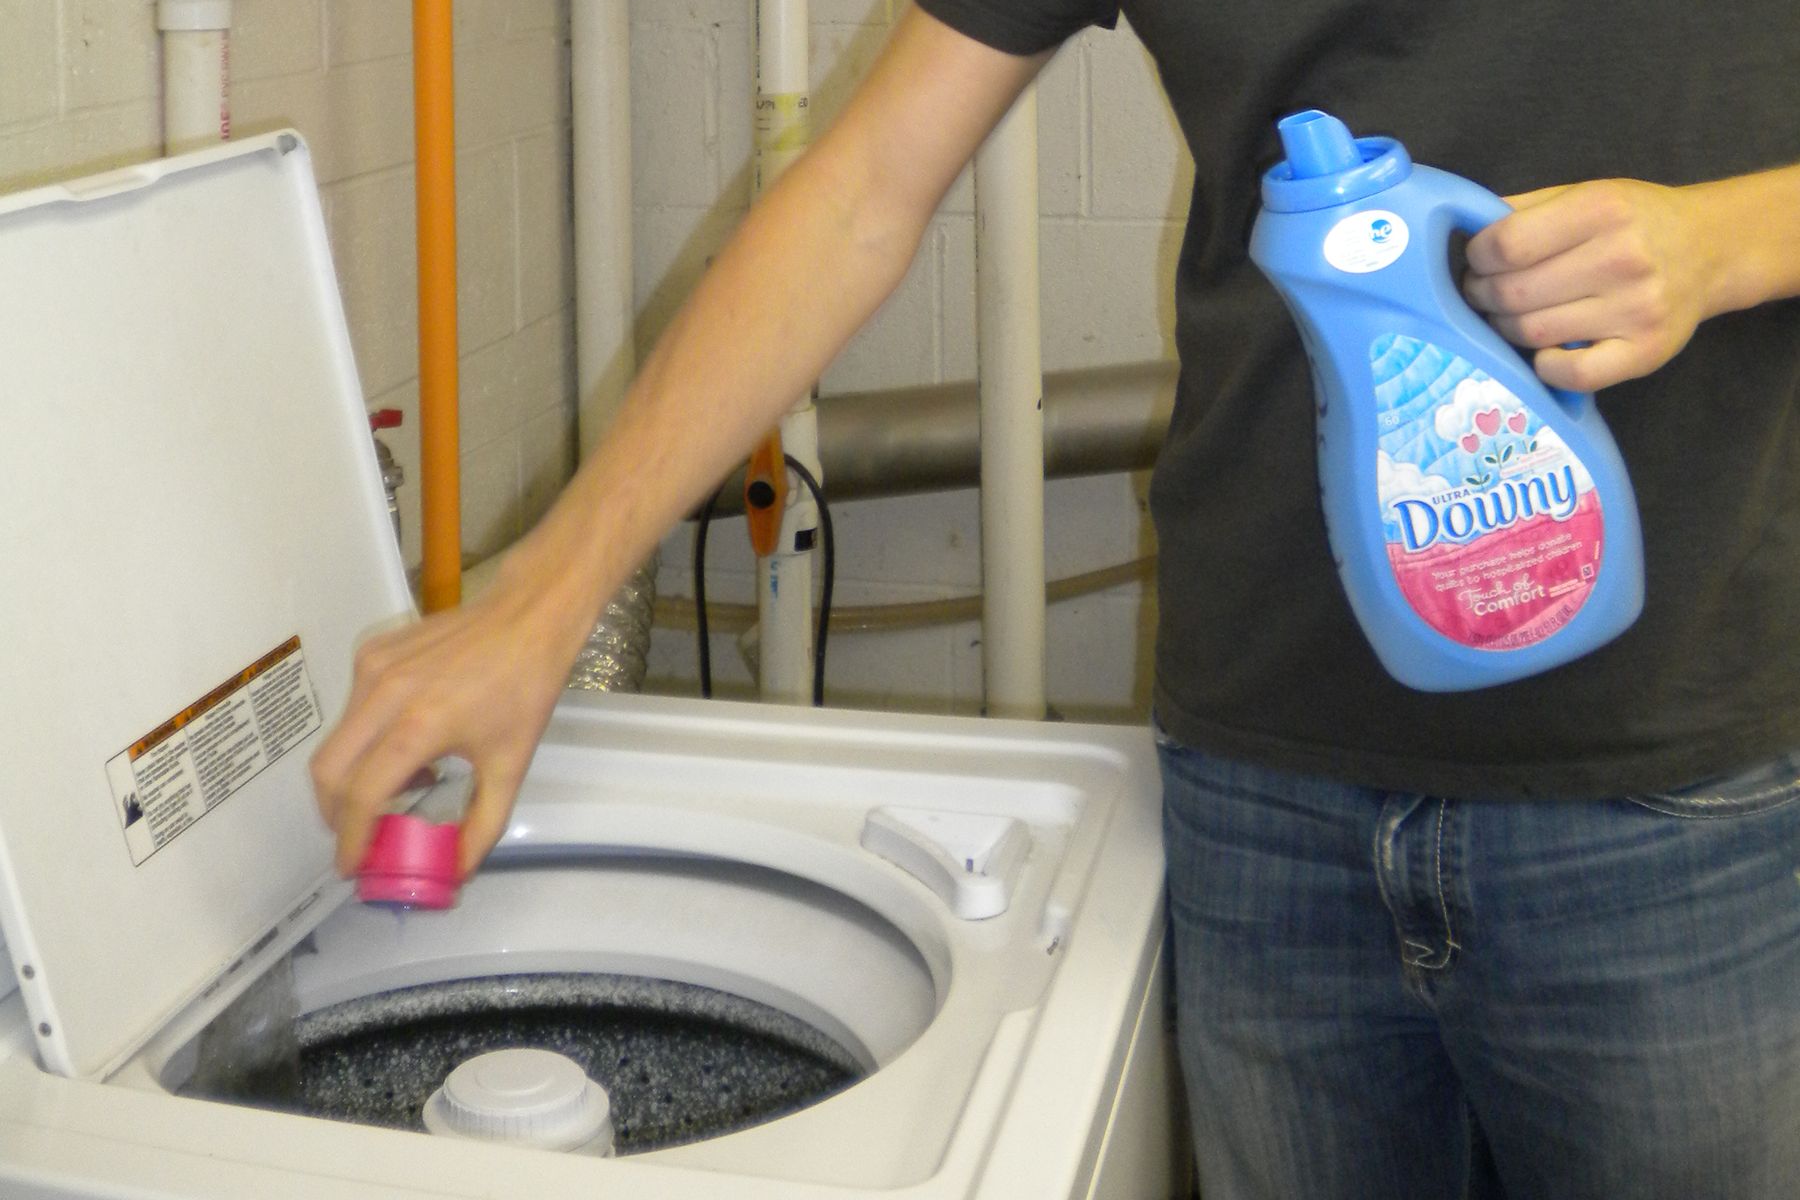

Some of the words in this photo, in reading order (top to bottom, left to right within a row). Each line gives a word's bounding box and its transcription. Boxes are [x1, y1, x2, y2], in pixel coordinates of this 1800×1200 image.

[1393, 465, 1578, 552] Downy
[1432, 488, 1471, 506] ULTRA
[1457, 581, 1511, 609] Touch
[1513, 573, 1535, 591] of
[1467, 573, 1480, 585] to
[1474, 584, 1545, 616] Comfort
